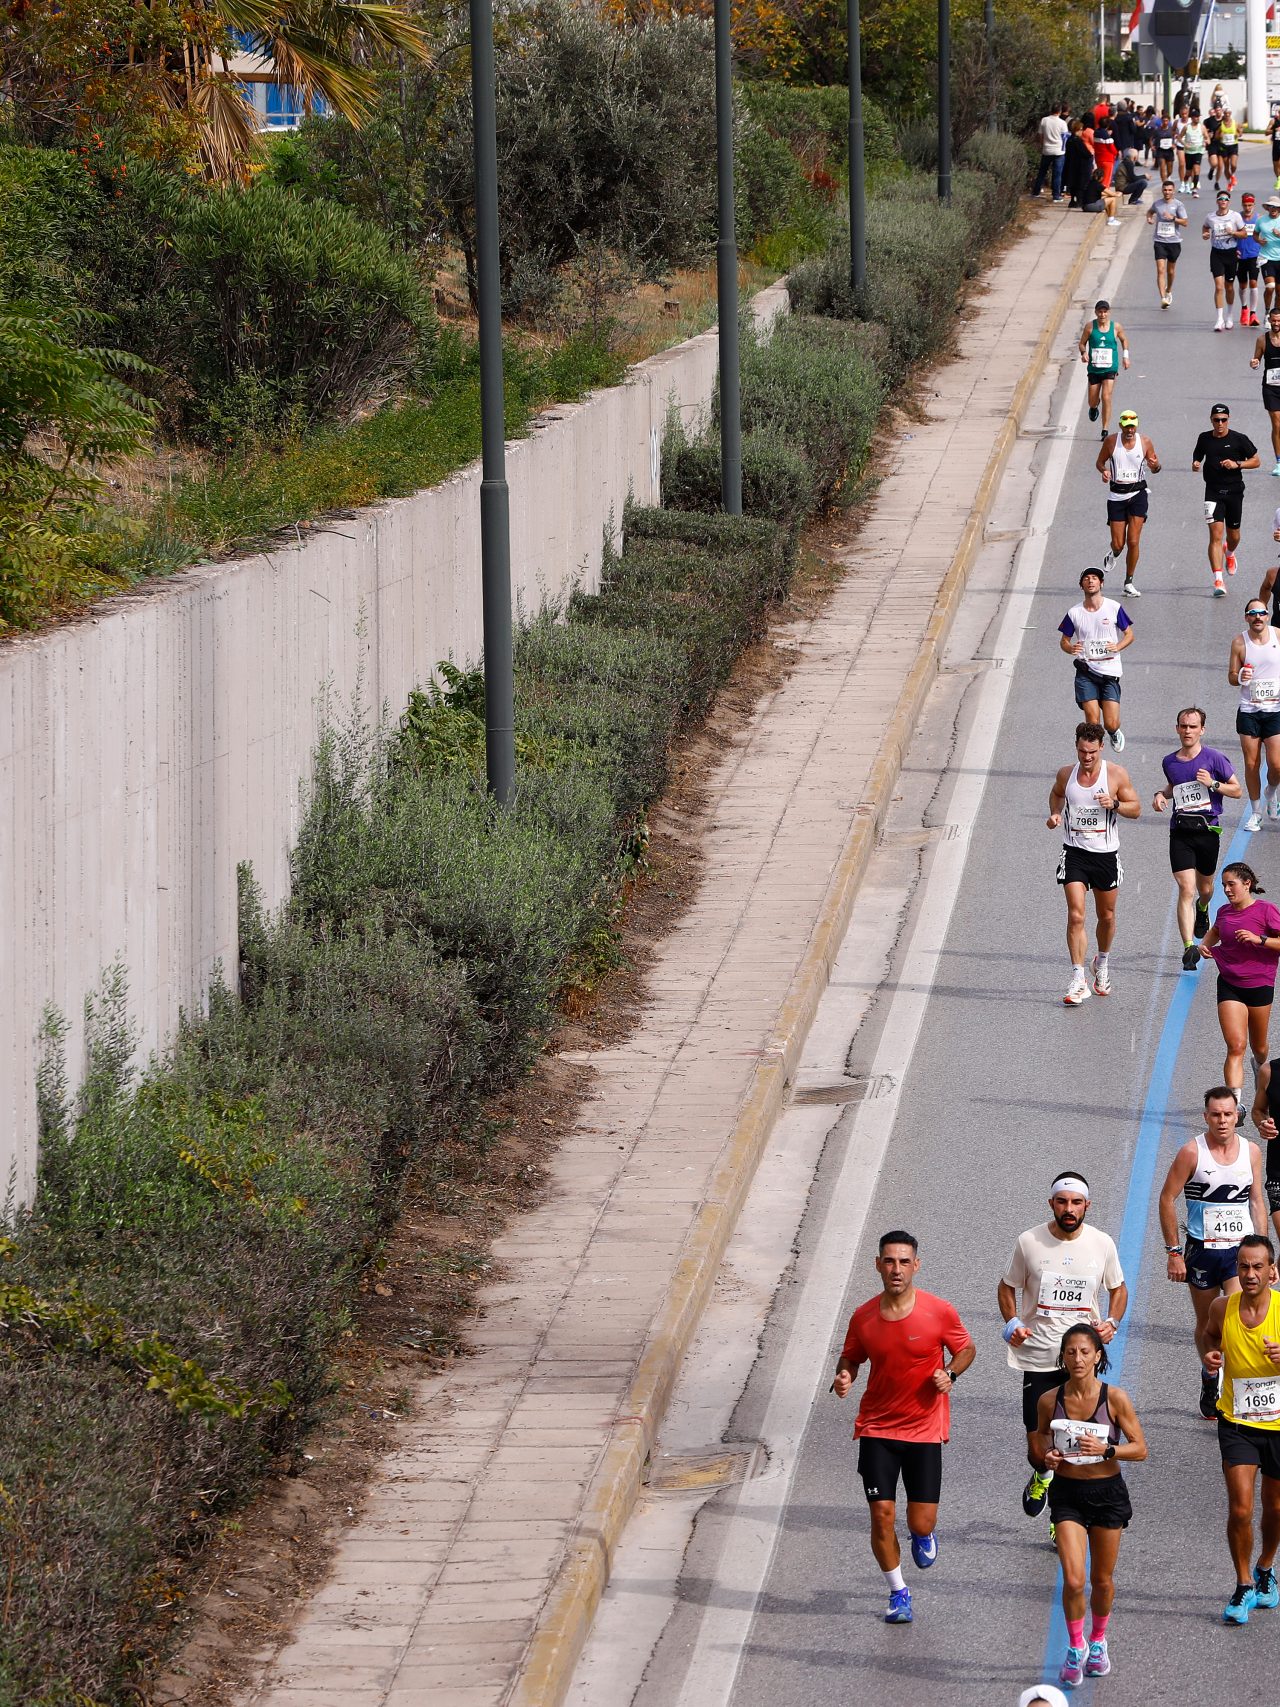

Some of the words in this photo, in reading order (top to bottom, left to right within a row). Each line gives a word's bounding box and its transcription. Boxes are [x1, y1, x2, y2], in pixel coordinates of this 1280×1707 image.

[1256, 689, 1274, 697] 1050
[1182, 792, 1202, 803] 1150
[1076, 817, 1098, 826] 7968
[1214, 1221, 1243, 1232] 4160
[1052, 1290, 1082, 1302] 1084
[1245, 1392, 1276, 1407] 1696
